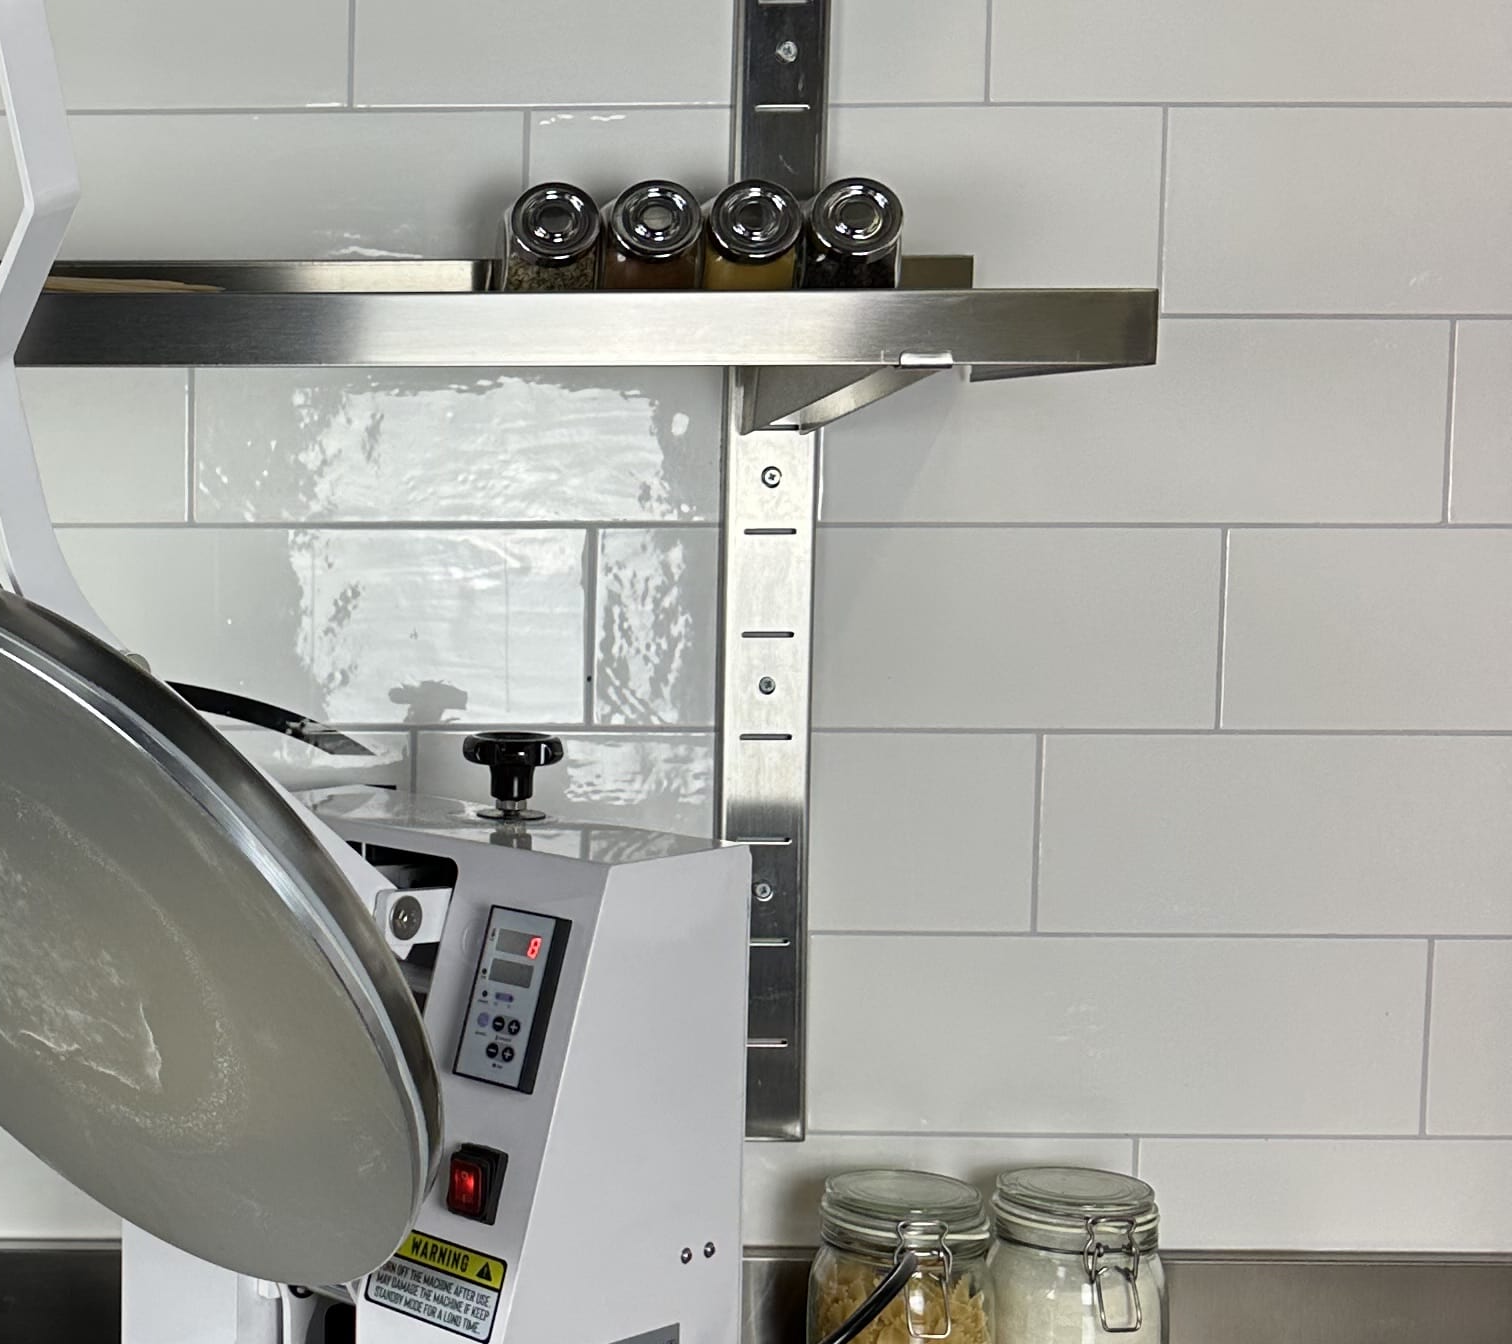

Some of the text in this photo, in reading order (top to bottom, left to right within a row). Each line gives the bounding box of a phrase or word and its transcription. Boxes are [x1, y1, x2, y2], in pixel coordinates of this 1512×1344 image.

[411, 1237, 470, 1273] WARNING
[376, 1270, 490, 1321] MAY DAMAGE THE MACHINE IF KEEP
[397, 1264, 410, 1278] OFF
[410, 1268, 423, 1283] THE
[423, 1272, 454, 1295] MACHINE
[454, 1285, 476, 1302] AFTER
[374, 1285, 404, 1306] STANDBY
[403, 1296, 424, 1315] MODE
[424, 1304, 437, 1318] FOR
[443, 1310, 462, 1327] LONG
